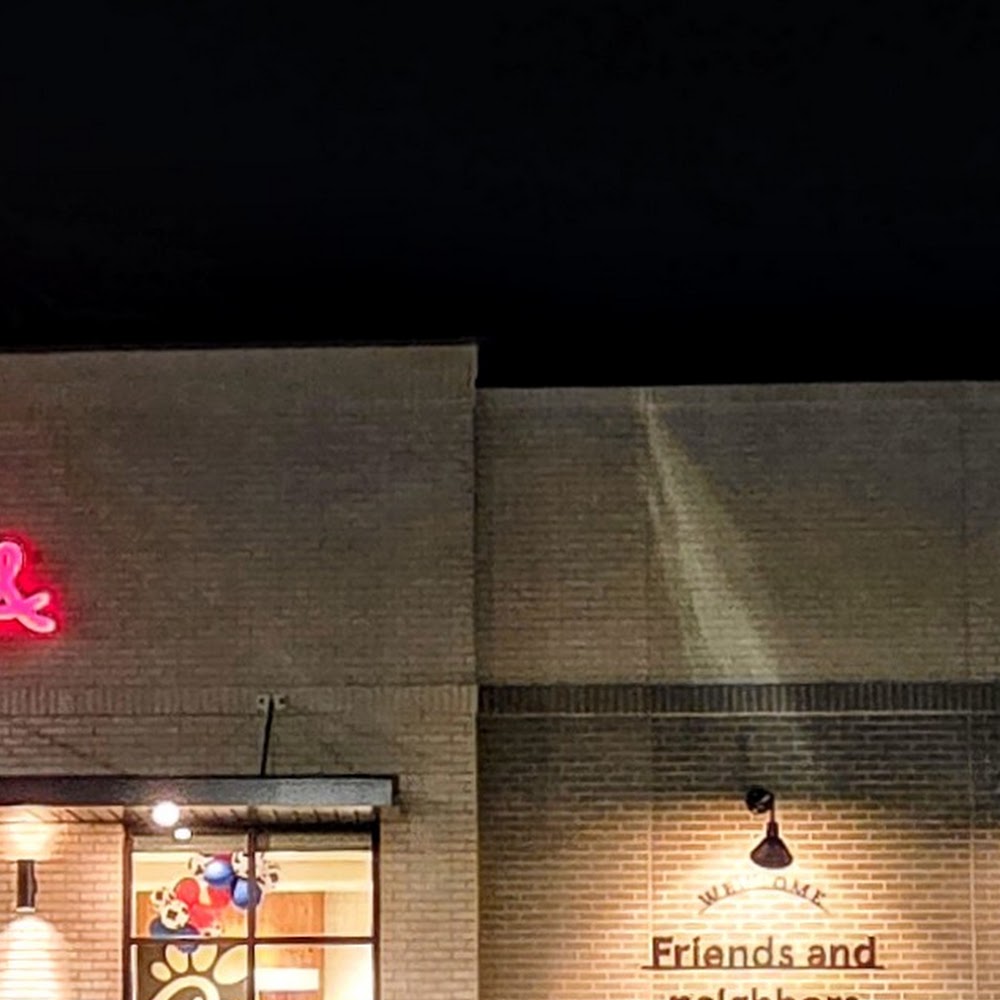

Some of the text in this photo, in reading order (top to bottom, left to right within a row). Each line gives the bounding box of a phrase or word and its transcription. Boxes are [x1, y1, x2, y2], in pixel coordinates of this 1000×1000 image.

[698, 876, 827, 905] WEOME
[652, 936, 876, 967] Friends and
